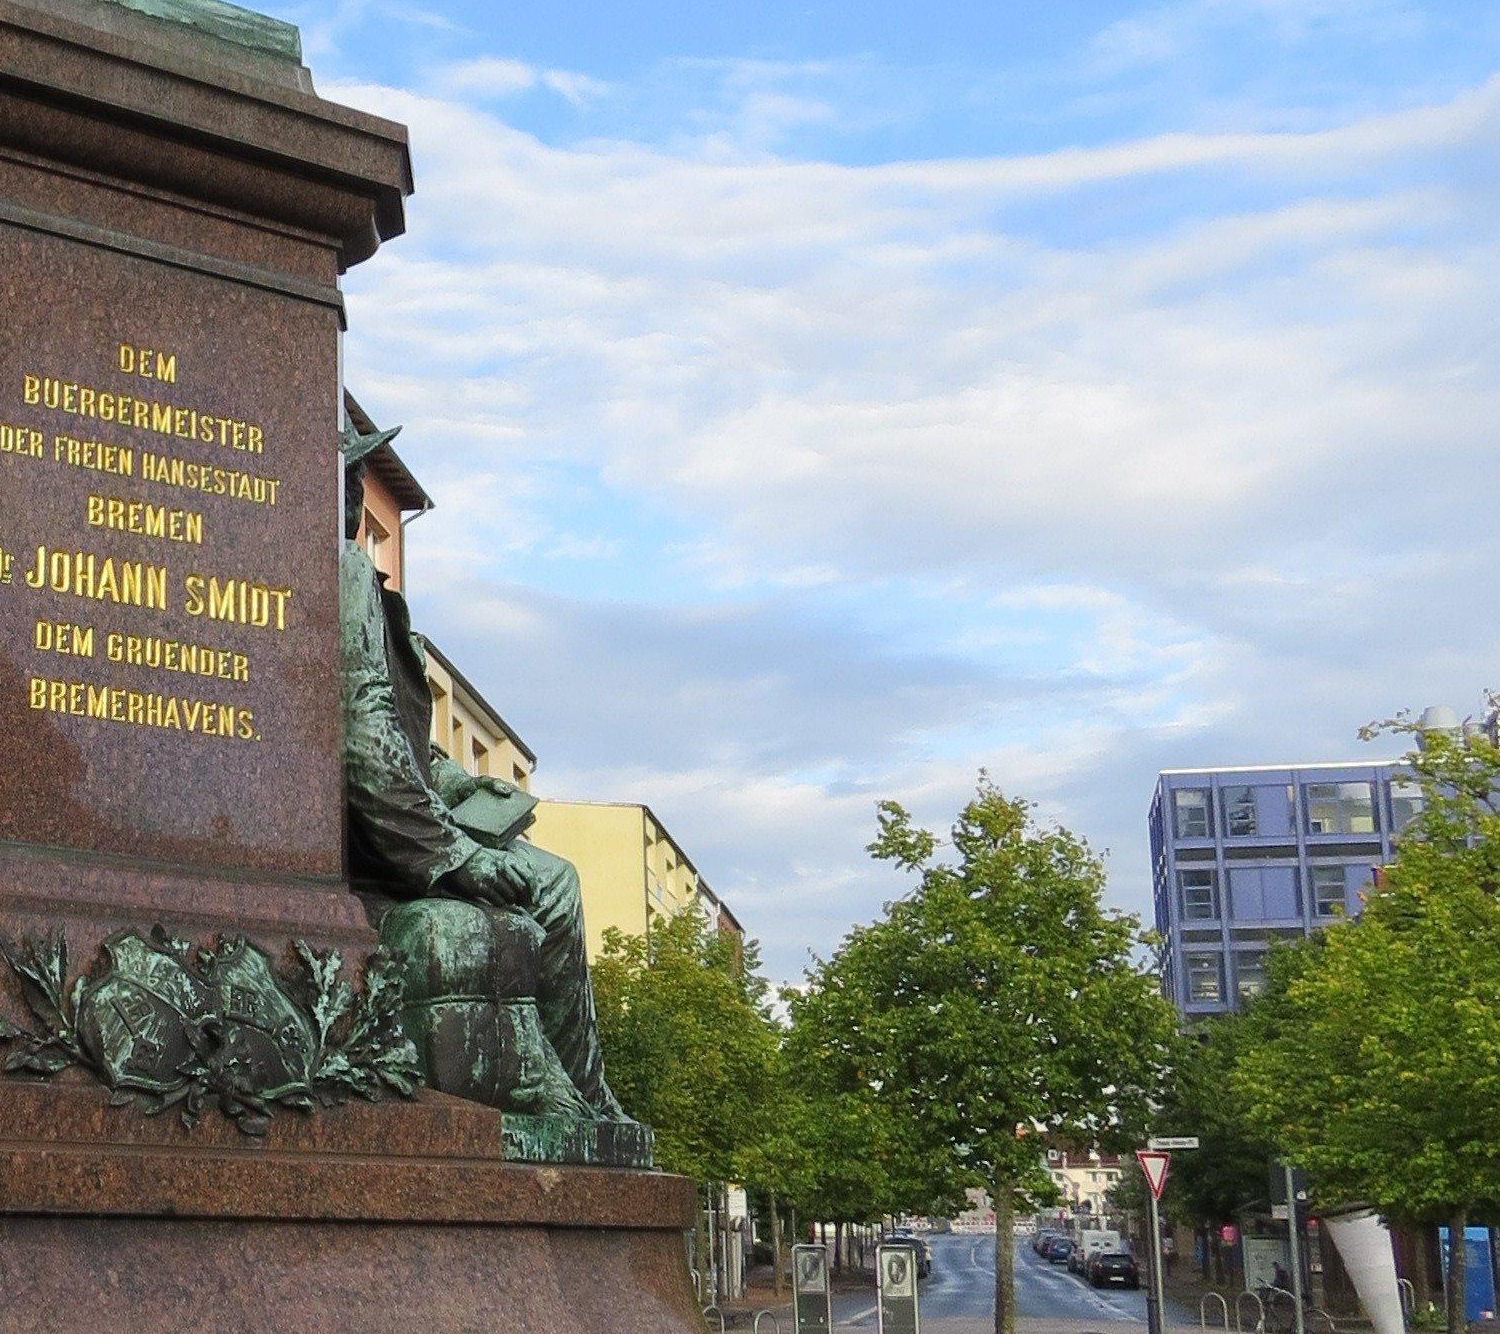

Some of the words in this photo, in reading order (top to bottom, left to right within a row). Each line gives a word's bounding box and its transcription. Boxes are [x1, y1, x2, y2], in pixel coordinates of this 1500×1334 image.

[118, 342, 177, 383] DEM
[23, 373, 264, 454] BUERGERMEISTER
[54, 435, 133, 477] FREIEN
[142, 453, 280, 506] HANSESTADT
[87, 494, 204, 545] BREMEN
[25, 544, 168, 611] JOHANN
[184, 573, 292, 631] SMIDT
[35, 619, 94, 657] DEM
[106, 631, 249, 682] GRUENDER
[27, 677, 262, 742] BREMERHAVENS.
